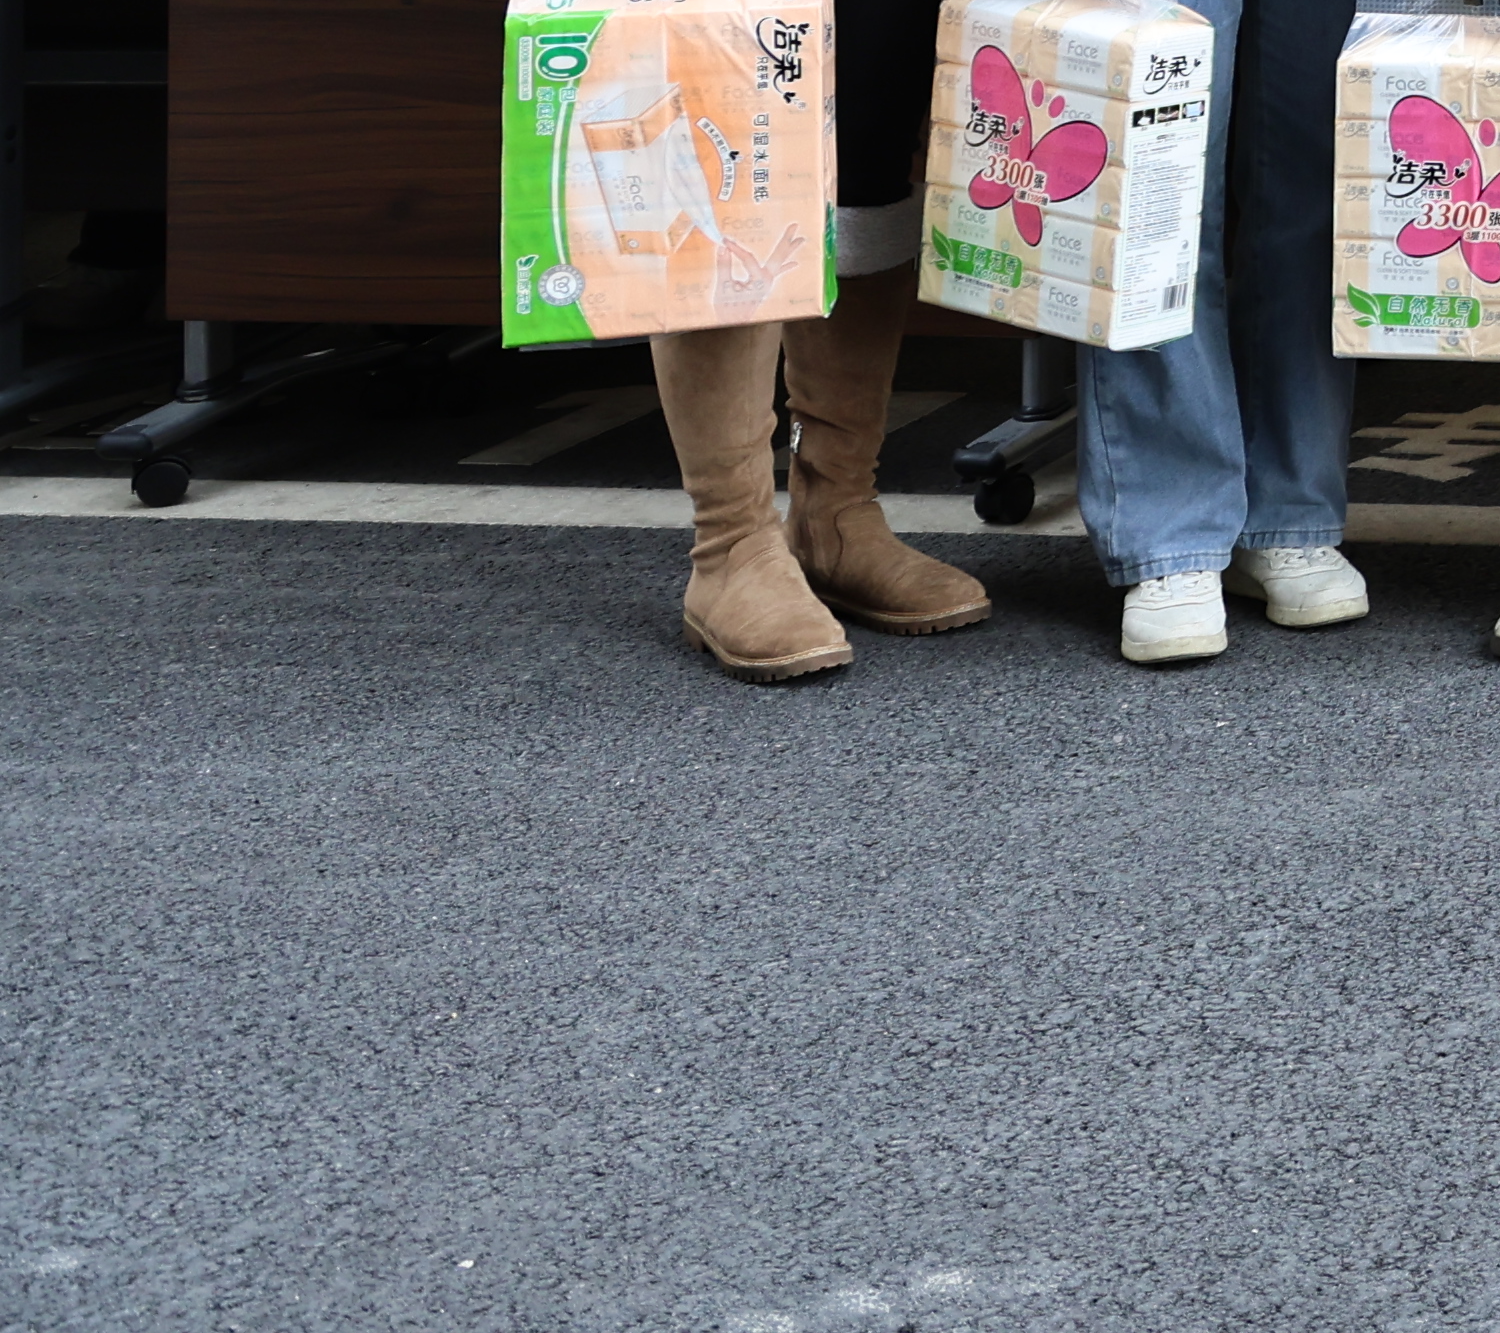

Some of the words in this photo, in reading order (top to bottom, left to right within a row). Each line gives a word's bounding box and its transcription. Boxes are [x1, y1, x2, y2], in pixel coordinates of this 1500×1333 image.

[972, 21, 1001, 39] Face
[536, 33, 590, 81] 10
[1067, 40, 1098, 59] Face
[1385, 76, 1427, 93] Face
[753, 113, 770, 204] 可湿水面纸
[957, 205, 987, 224] Face
[1052, 232, 1082, 251] Face
[1049, 287, 1078, 307] Face
[1387, 297, 1474, 314] 自然无香
[1411, 312, 1468, 328] Natural
